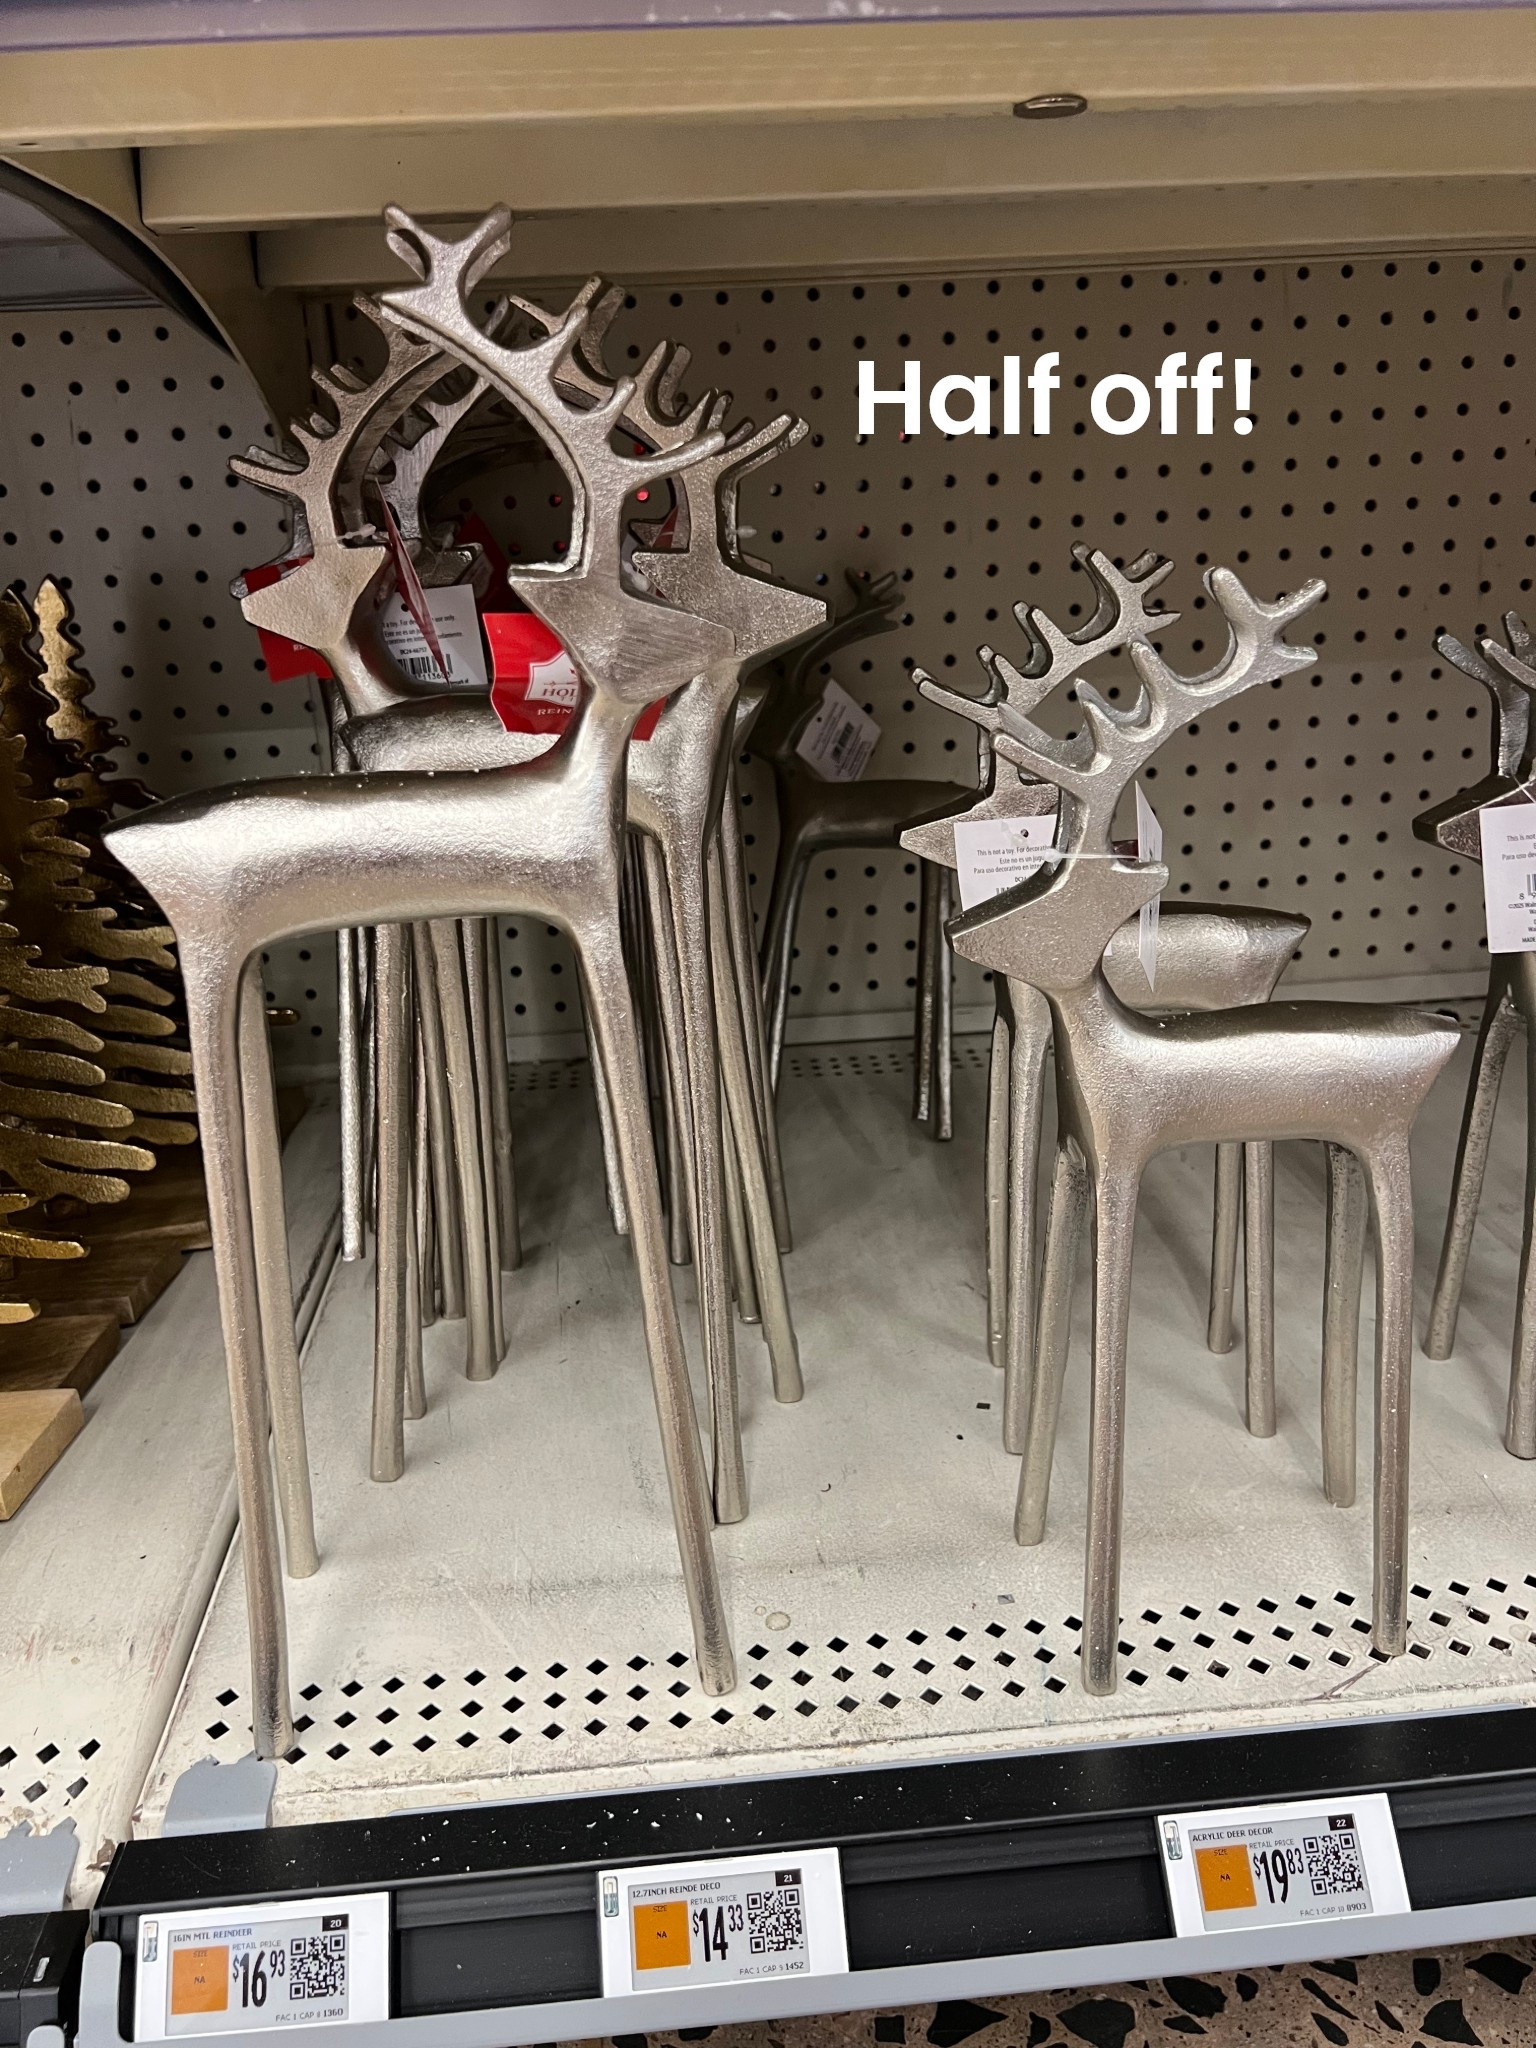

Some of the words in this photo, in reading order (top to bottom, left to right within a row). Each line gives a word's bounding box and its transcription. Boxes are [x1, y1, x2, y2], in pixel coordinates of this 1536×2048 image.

[1193, 1831, 1224, 1842] ACRYLIC
[1227, 1830, 1246, 1838] DEER
[1249, 1827, 1273, 1836] DECOR
[1336, 1819, 1346, 1827] 22
[1249, 1840, 1272, 1849] RETAIL
[633, 1888, 666, 1898] 12.7INCH
[670, 1885, 698, 1894] REINDE
[701, 1882, 721, 1891] DECO
[691, 1897, 714, 1905] RETAIL
[1300, 1909, 1314, 1917] FAC
[174, 1934, 192, 1943] 16IN
[193, 1933, 210, 1941] MTL
[330, 1919, 342, 1927] 20
[657, 1931, 667, 1939] NA
[232, 1942, 256, 1950] RETAIL
[260, 1940, 281, 1948] PRICE
[763, 1965, 776, 1973] CAP
[786, 1962, 804, 1970] 1452
[194, 1976, 205, 1984] NA
[276, 2013, 290, 2021] FAC
[300, 2012, 314, 2020] CAP
[323, 2009, 343, 2017] 1360
